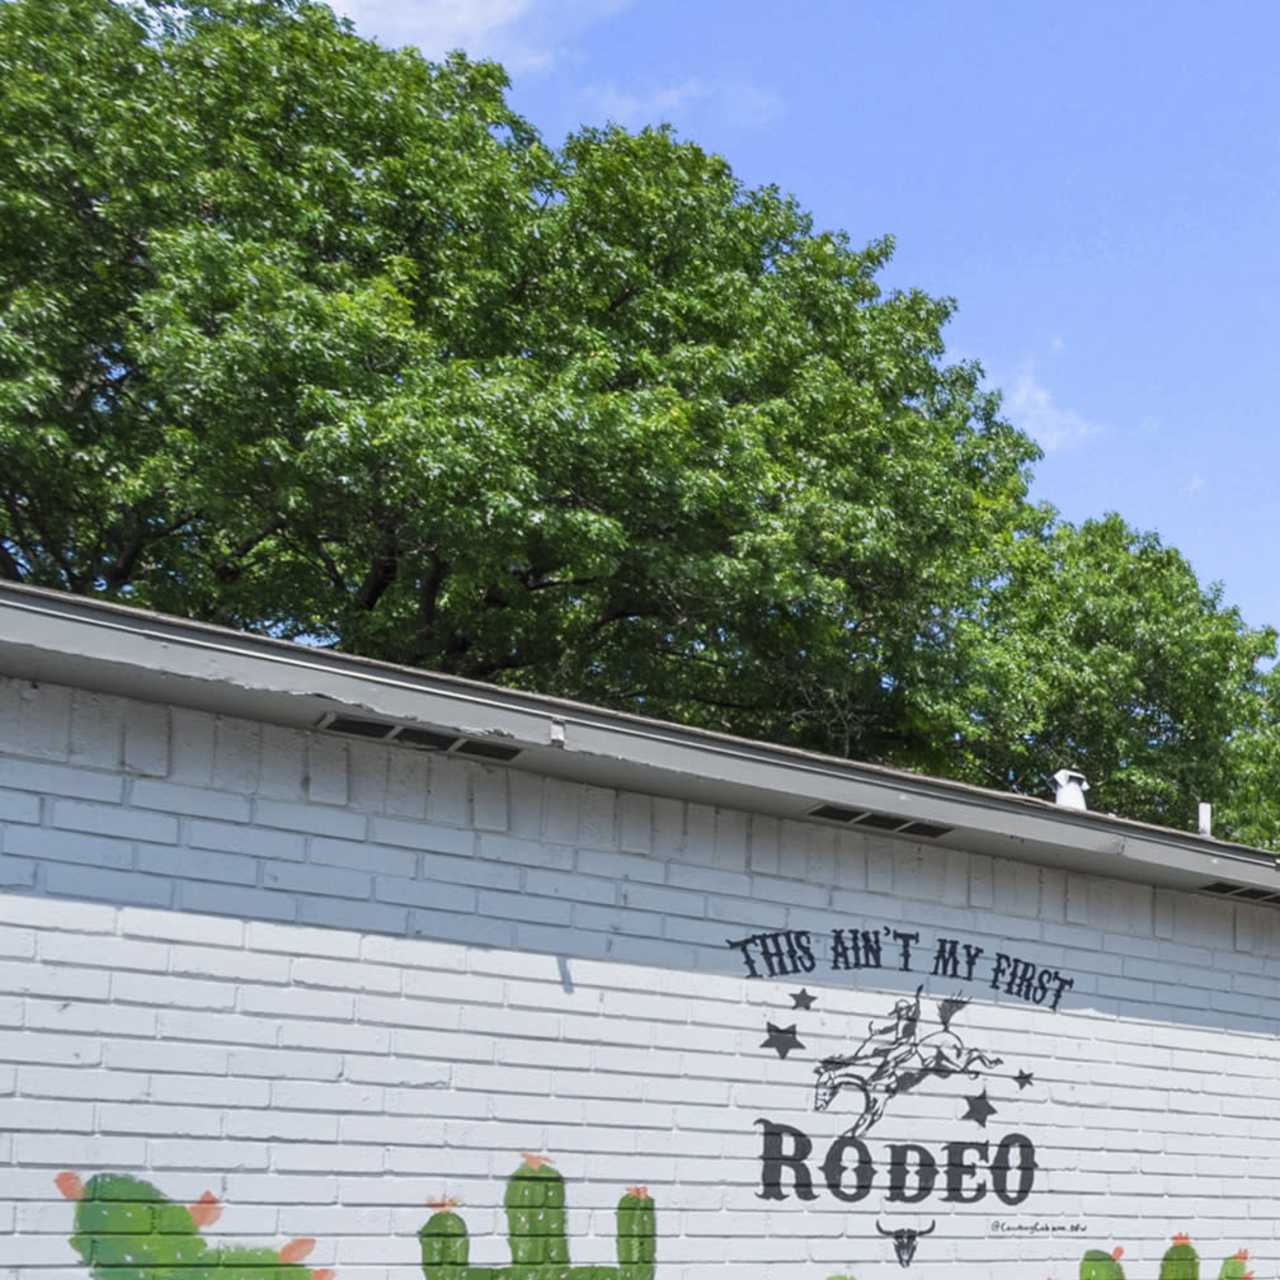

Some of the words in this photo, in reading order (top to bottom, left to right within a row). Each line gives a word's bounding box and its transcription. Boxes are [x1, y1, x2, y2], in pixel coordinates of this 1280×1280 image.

[726, 931, 817, 978] THIS
[831, 927, 919, 971] AIN'T
[930, 938, 983, 981] MY
[990, 952, 1073, 1012] FIRST
[753, 1118, 1038, 1206] RODEO
